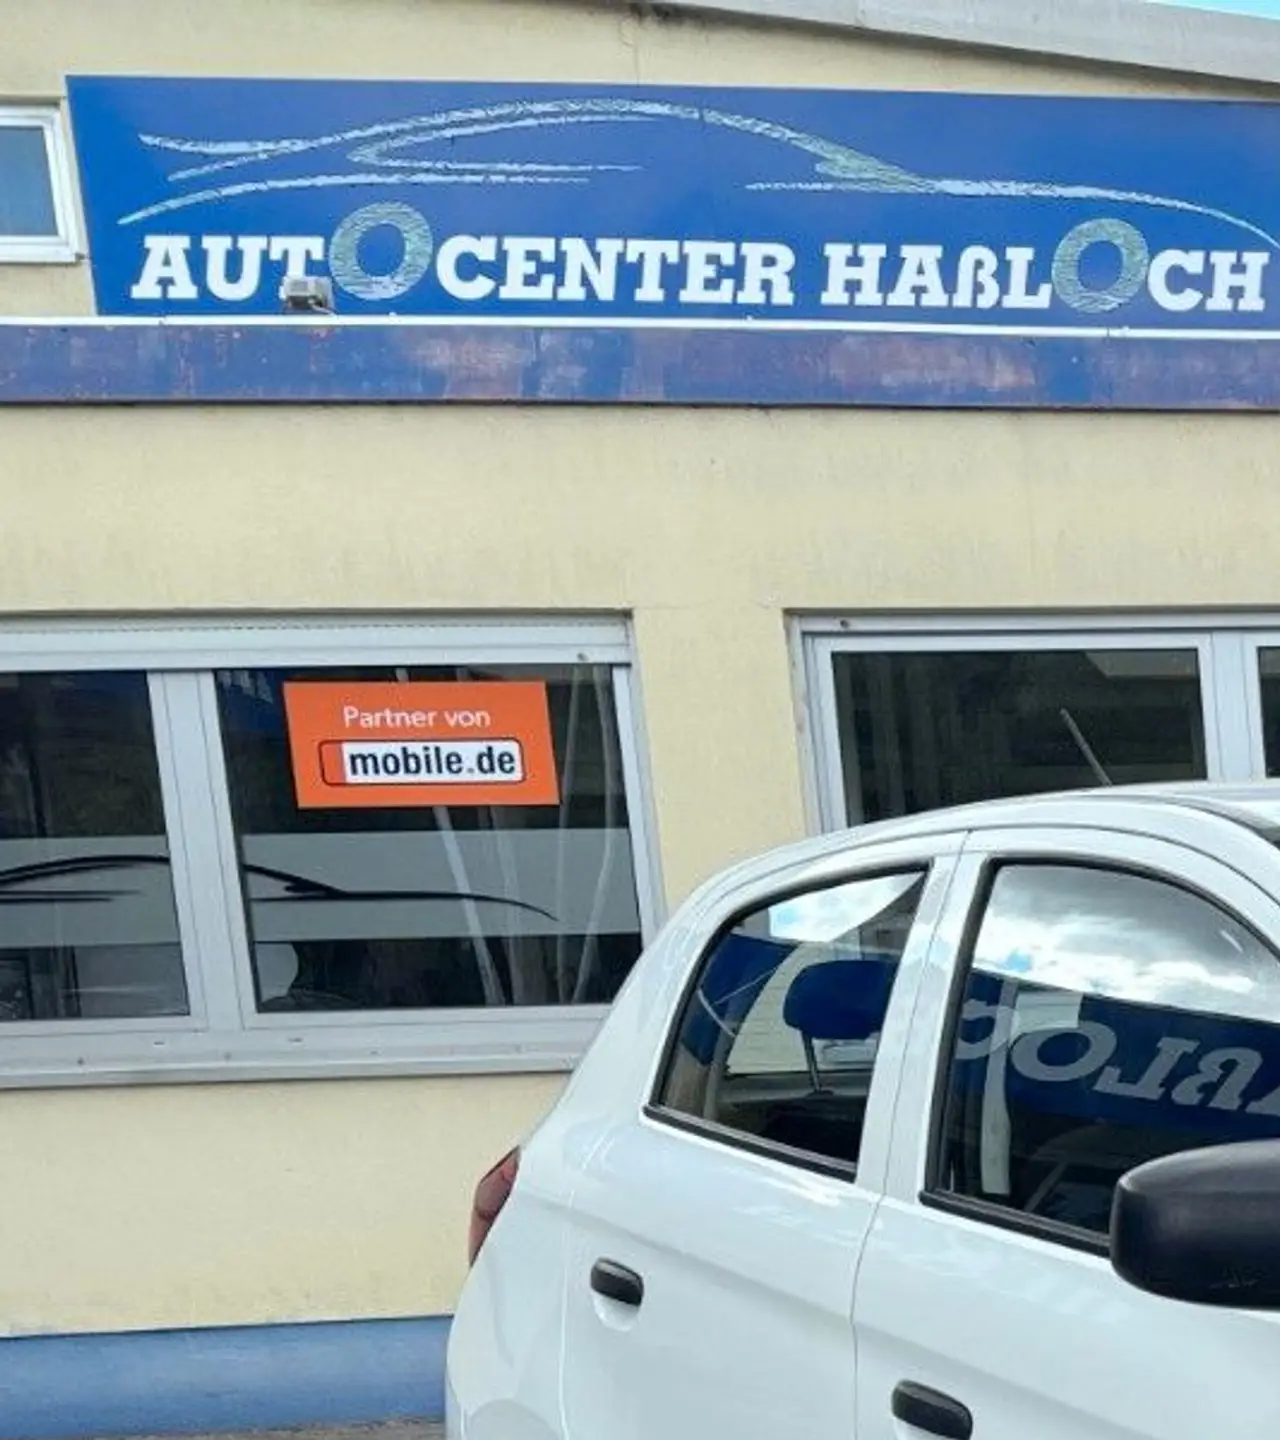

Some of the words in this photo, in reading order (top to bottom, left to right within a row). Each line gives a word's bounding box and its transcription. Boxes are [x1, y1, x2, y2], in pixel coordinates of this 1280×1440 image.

[130, 201, 796, 306] AUTOCENTER
[820, 217, 1271, 313] HAßLOCH
[343, 705, 437, 729] Partner
[444, 709, 491, 728] von
[349, 745, 517, 776] mobile.de
